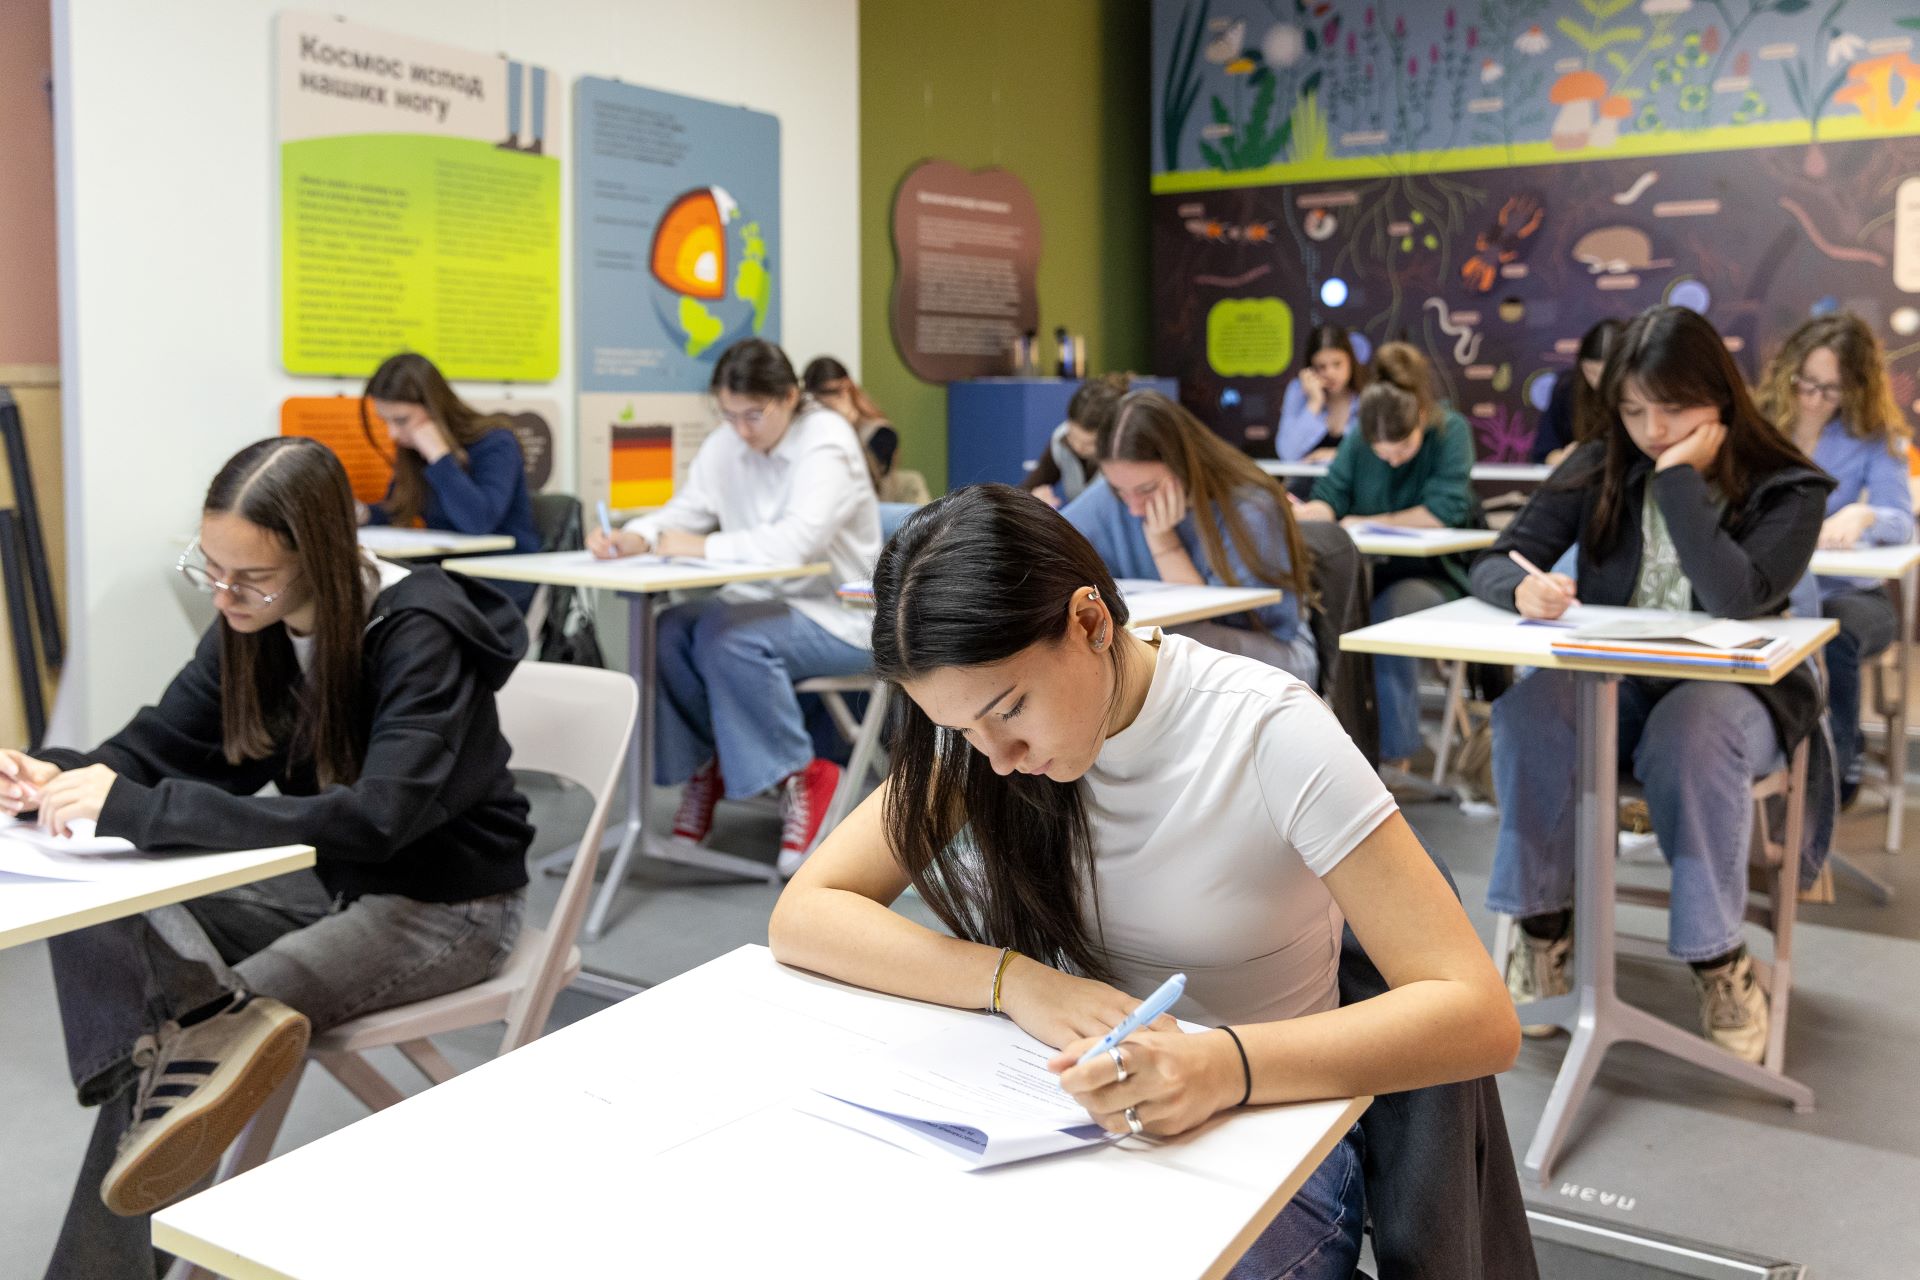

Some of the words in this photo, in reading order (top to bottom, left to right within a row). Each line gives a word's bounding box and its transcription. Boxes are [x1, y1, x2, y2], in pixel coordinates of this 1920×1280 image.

[301, 34, 403, 79] Космос
[409, 65, 484, 100] испод
[300, 72, 387, 105] наших
[395, 91, 449, 123] ногу
[1559, 1182, 1636, 1211] ПАЗИ
